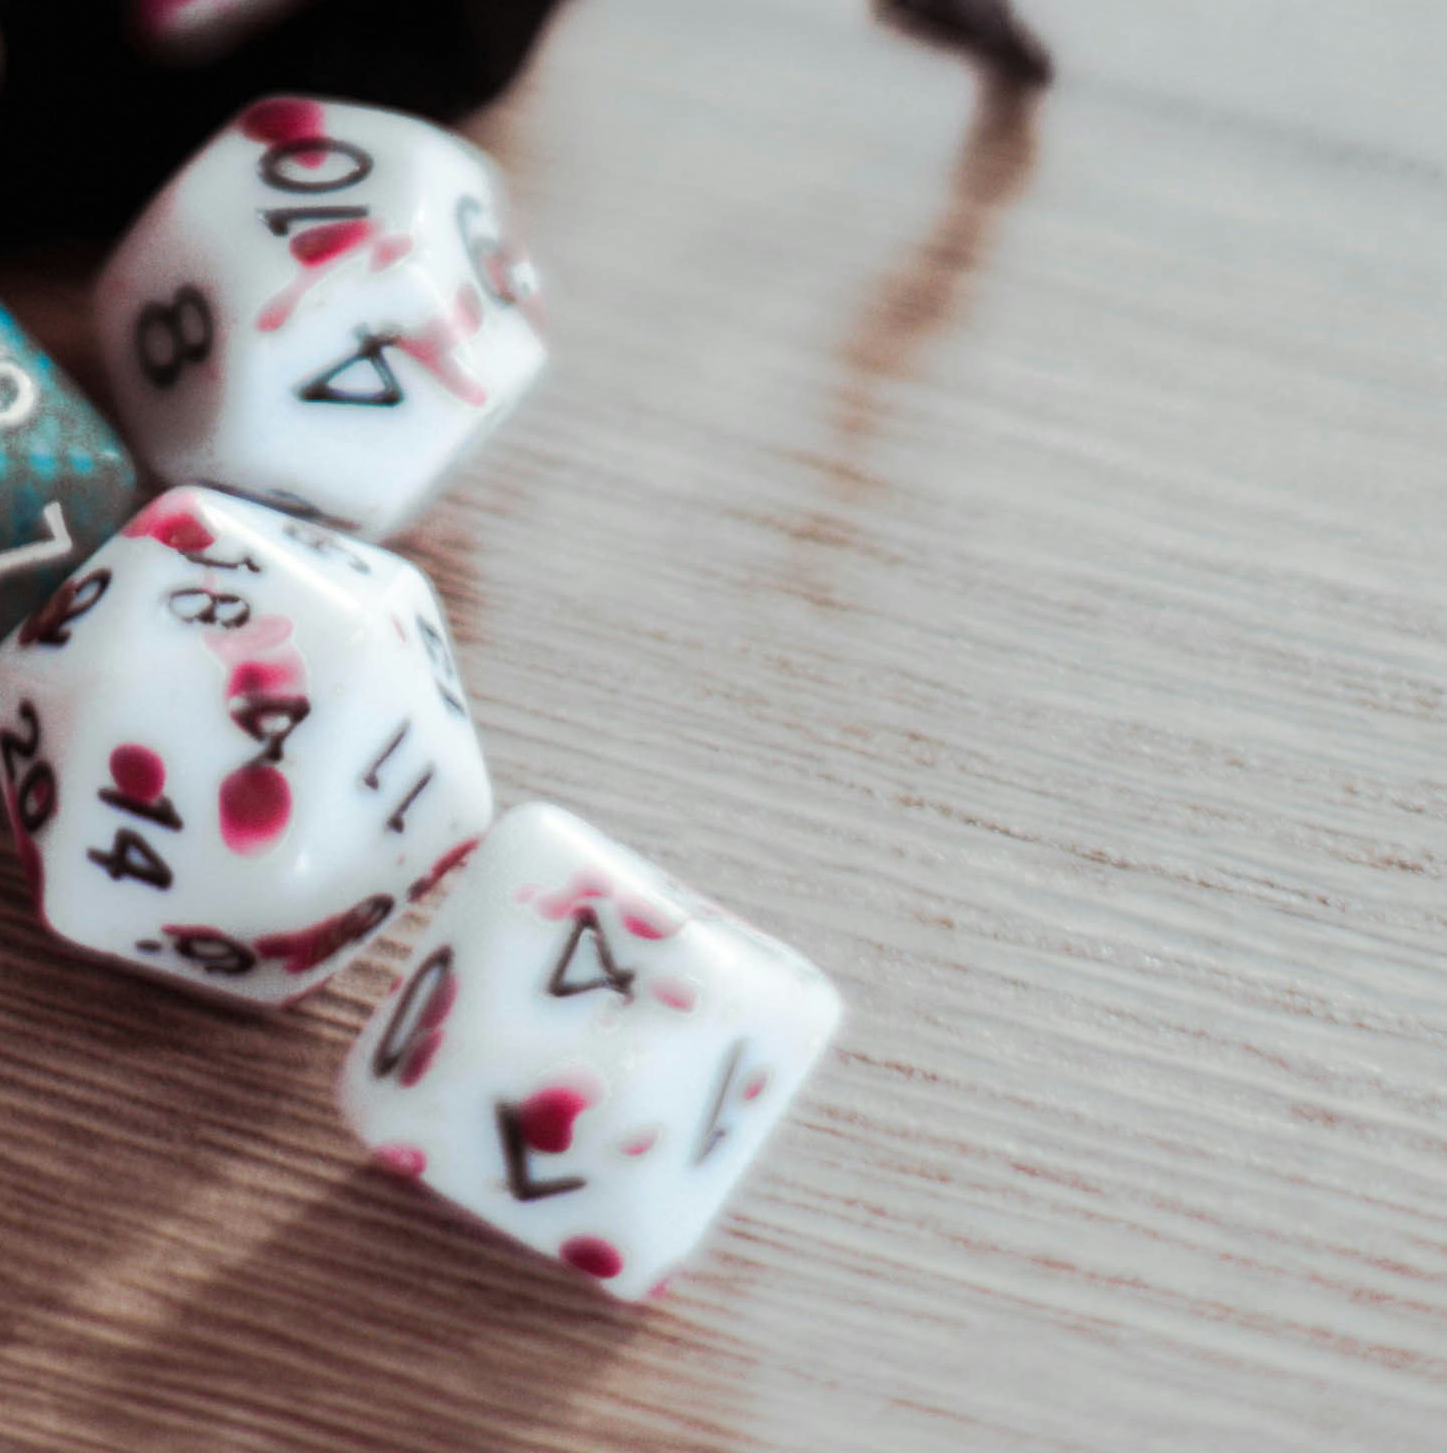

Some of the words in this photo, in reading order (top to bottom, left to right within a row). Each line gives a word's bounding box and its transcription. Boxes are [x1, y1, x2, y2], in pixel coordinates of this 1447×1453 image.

[258, 137, 373, 236] 10
[135, 284, 213, 388] 8
[294, 323, 404, 407] 4
[230, 692, 311, 769] 4
[362, 720, 434, 833] 11
[86, 785, 184, 891] 14
[546, 907, 635, 998] 4
[374, 945, 453, 1078] 0
[496, 1099, 587, 1202] 7
